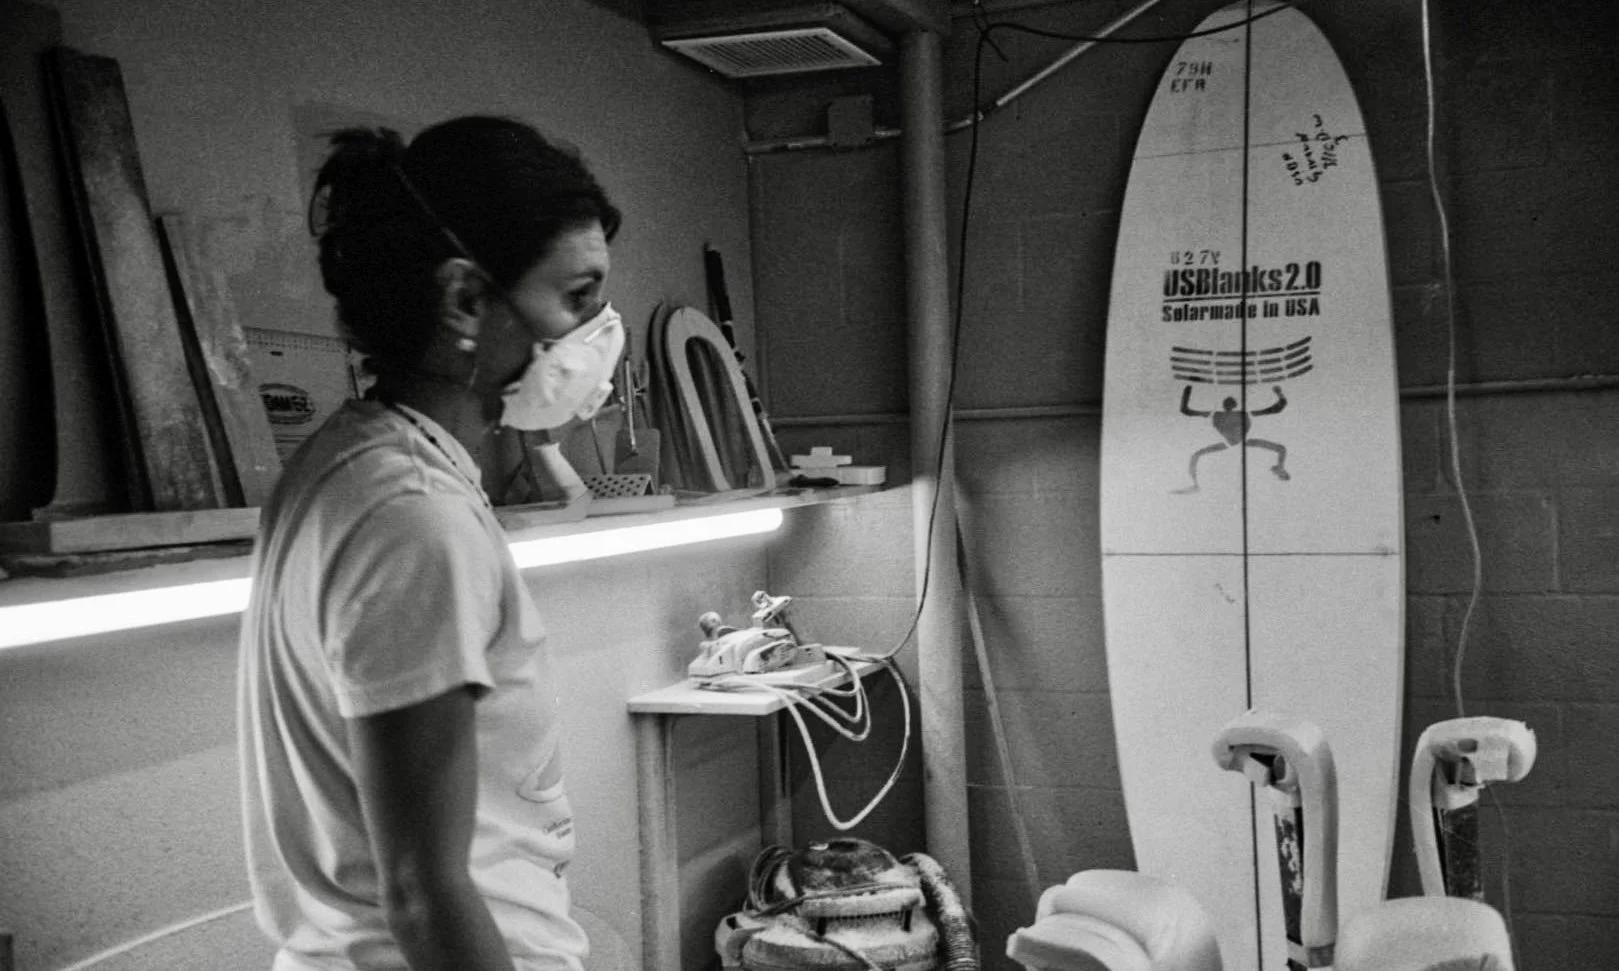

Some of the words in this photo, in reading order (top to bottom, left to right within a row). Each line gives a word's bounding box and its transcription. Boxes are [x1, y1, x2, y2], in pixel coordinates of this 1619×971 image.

[1162, 301, 1257, 322] Solarmade
[1263, 300, 1279, 318] in
[1285, 297, 1321, 317] USA
